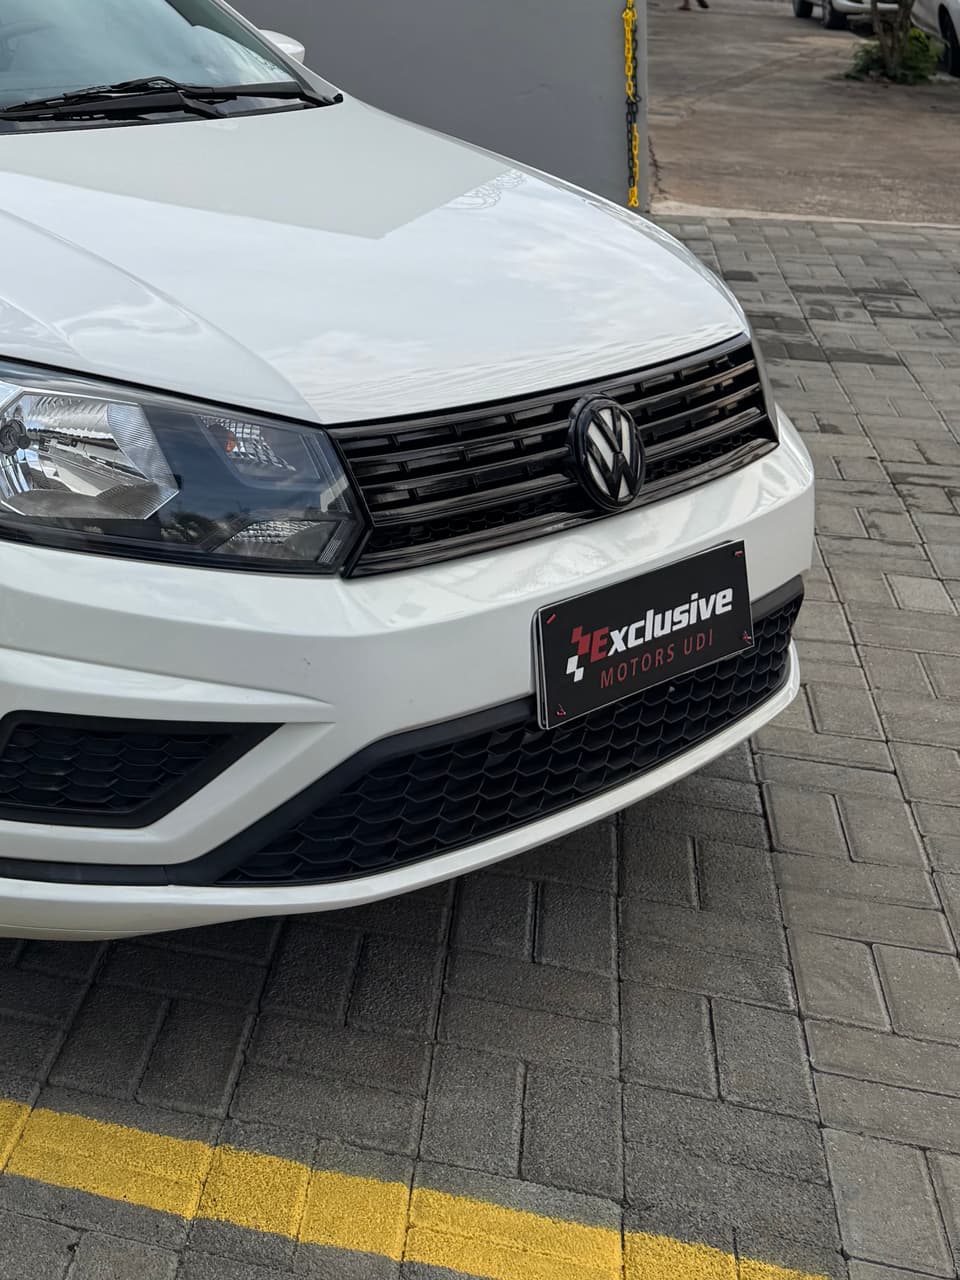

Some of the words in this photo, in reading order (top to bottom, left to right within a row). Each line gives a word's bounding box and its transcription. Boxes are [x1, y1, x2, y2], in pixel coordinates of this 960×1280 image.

[590, 587, 733, 663] Exclusive
[600, 643, 675, 689] MOTORS
[683, 628, 713, 656] UDI
